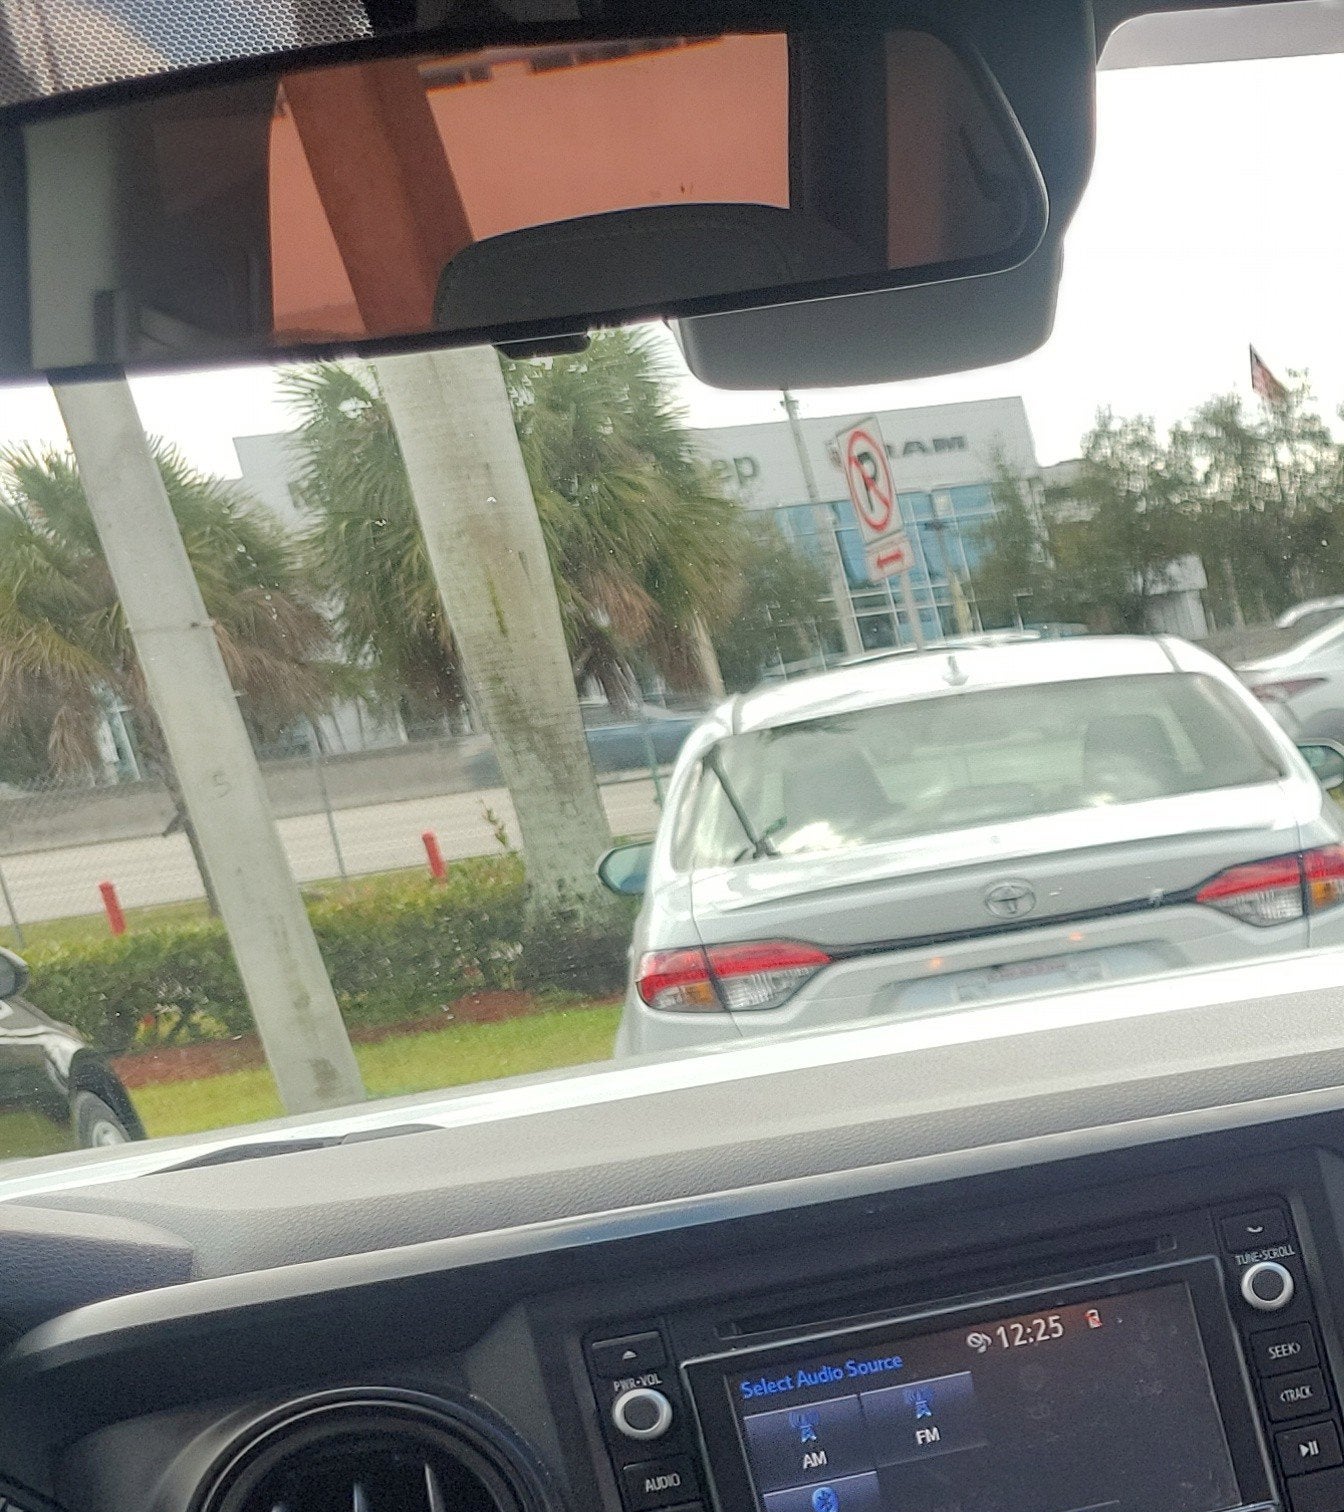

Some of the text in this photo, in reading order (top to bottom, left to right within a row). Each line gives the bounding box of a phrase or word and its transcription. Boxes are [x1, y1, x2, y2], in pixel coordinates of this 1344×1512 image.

[885, 436, 966, 458] AM
[996, 1315, 1064, 1348] 12:25
[740, 1355, 903, 1399] Select Audio Source
[915, 1426, 941, 1445] FM
[802, 1451, 827, 1470] AM
[645, 1473, 681, 1492] AUDIO
